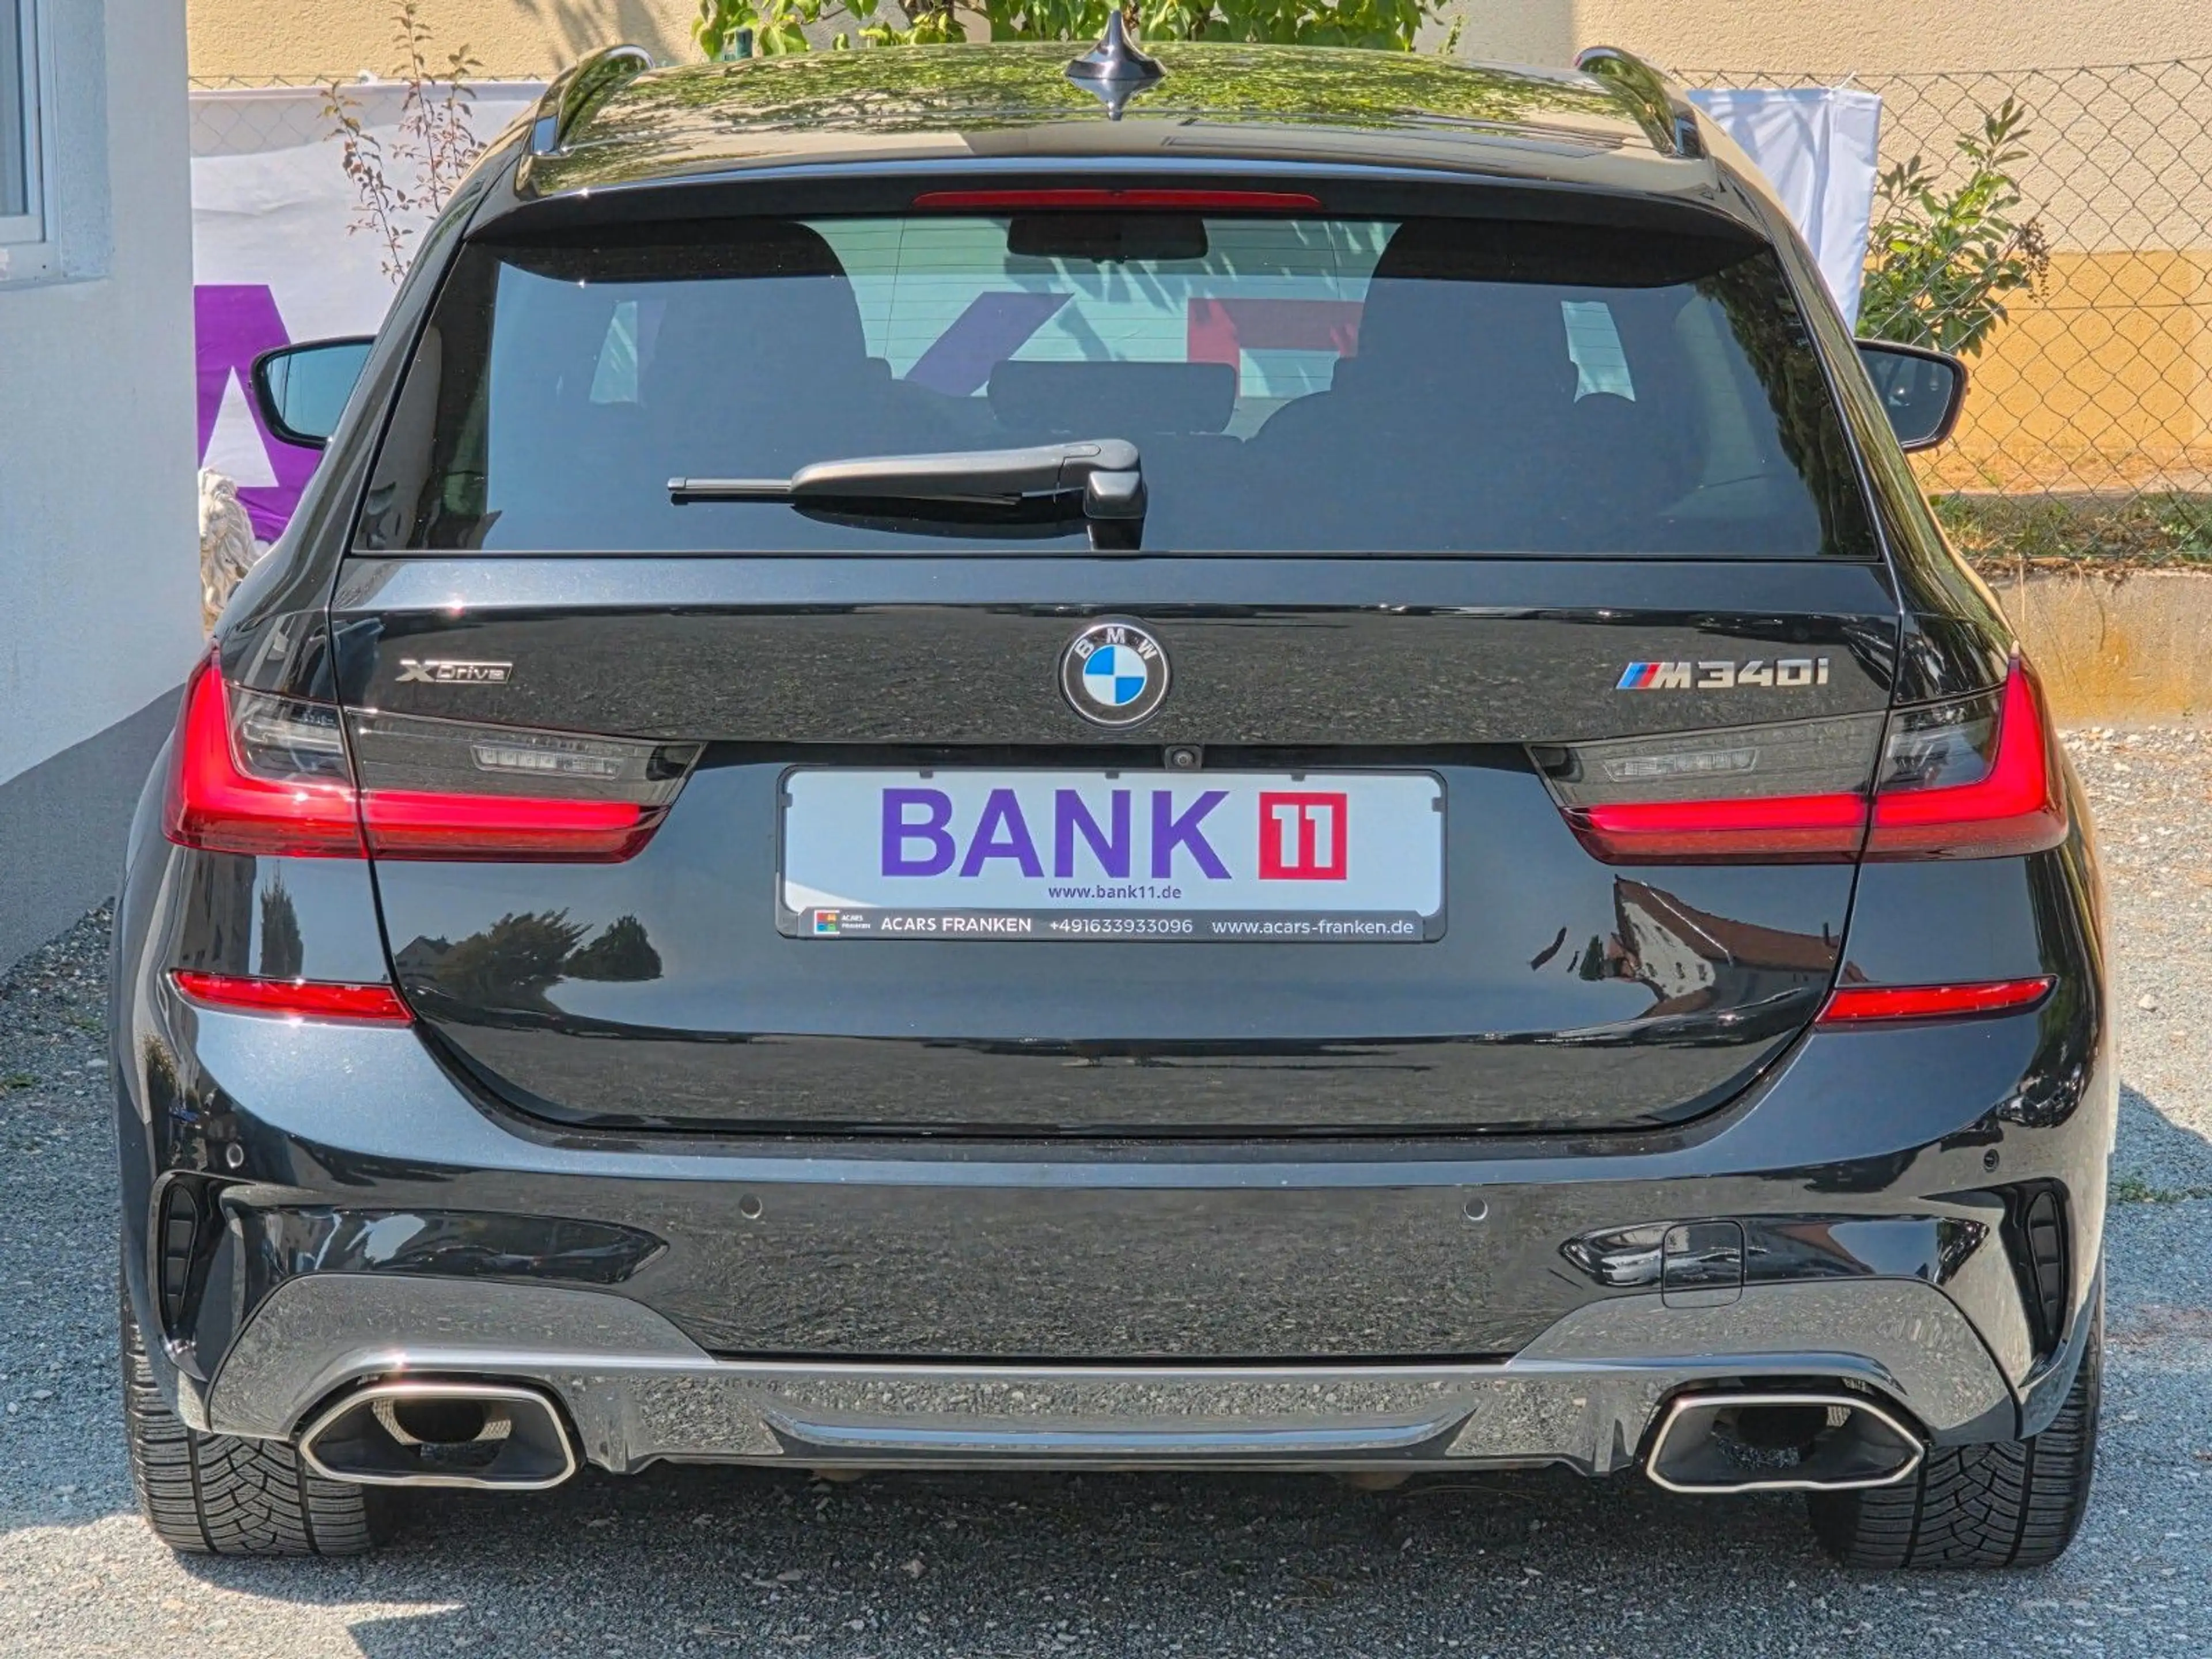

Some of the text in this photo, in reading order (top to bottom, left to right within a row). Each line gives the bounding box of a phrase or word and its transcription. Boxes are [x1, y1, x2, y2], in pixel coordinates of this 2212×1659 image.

[1075, 628, 1157, 660] BMW
[882, 789, 1334, 879] BANK 11
[1048, 884, 1182, 899] www.bank11.de
[880, 916, 937, 932] ACARS
[942, 917, 1032, 933] FRANKEN
[1050, 919, 1193, 933] +491633933096
[1212, 919, 1414, 935] www.acars-franken.de
